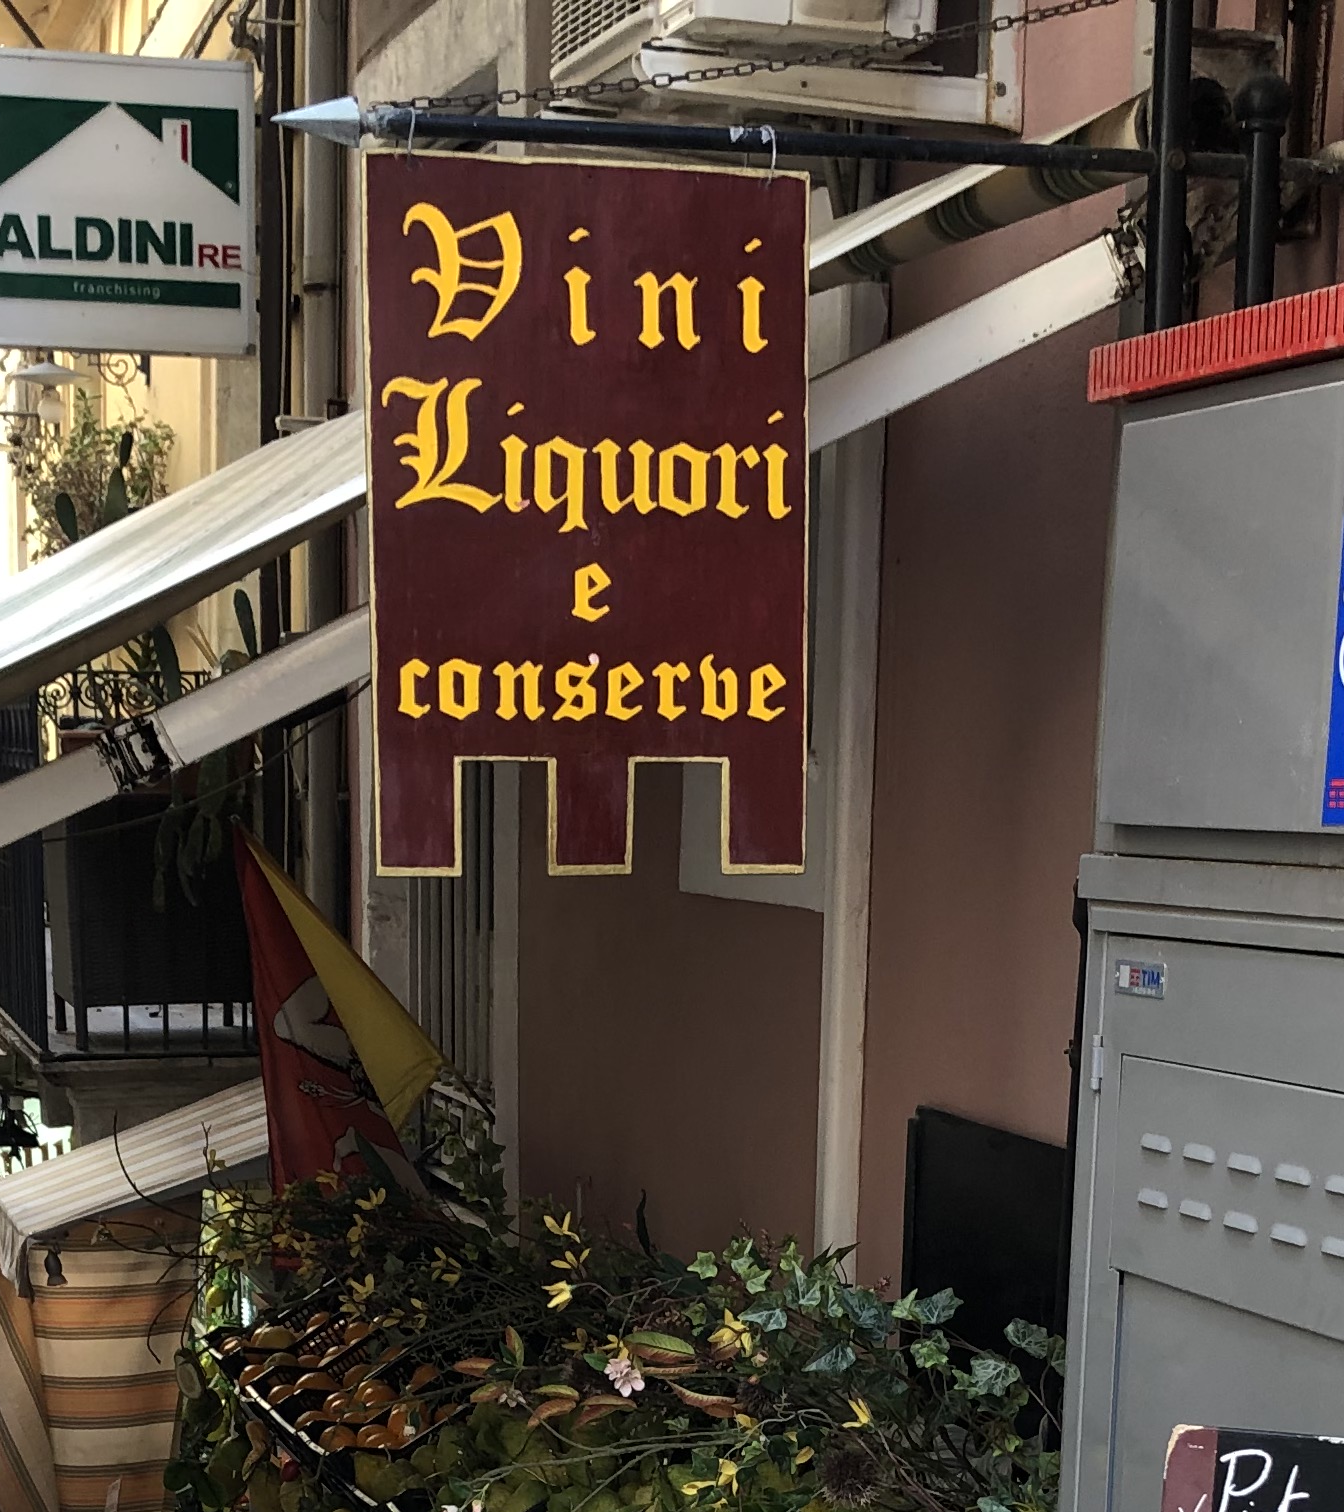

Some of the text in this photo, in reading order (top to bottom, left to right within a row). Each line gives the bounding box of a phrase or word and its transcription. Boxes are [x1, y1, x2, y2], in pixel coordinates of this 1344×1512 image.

[73, 280, 161, 301] franchising
[403, 202, 769, 354] Vini
[381, 376, 792, 533] Liquori
[570, 561, 612, 624] e
[397, 653, 788, 724] conserve
[1141, 968, 1161, 988] TIM
